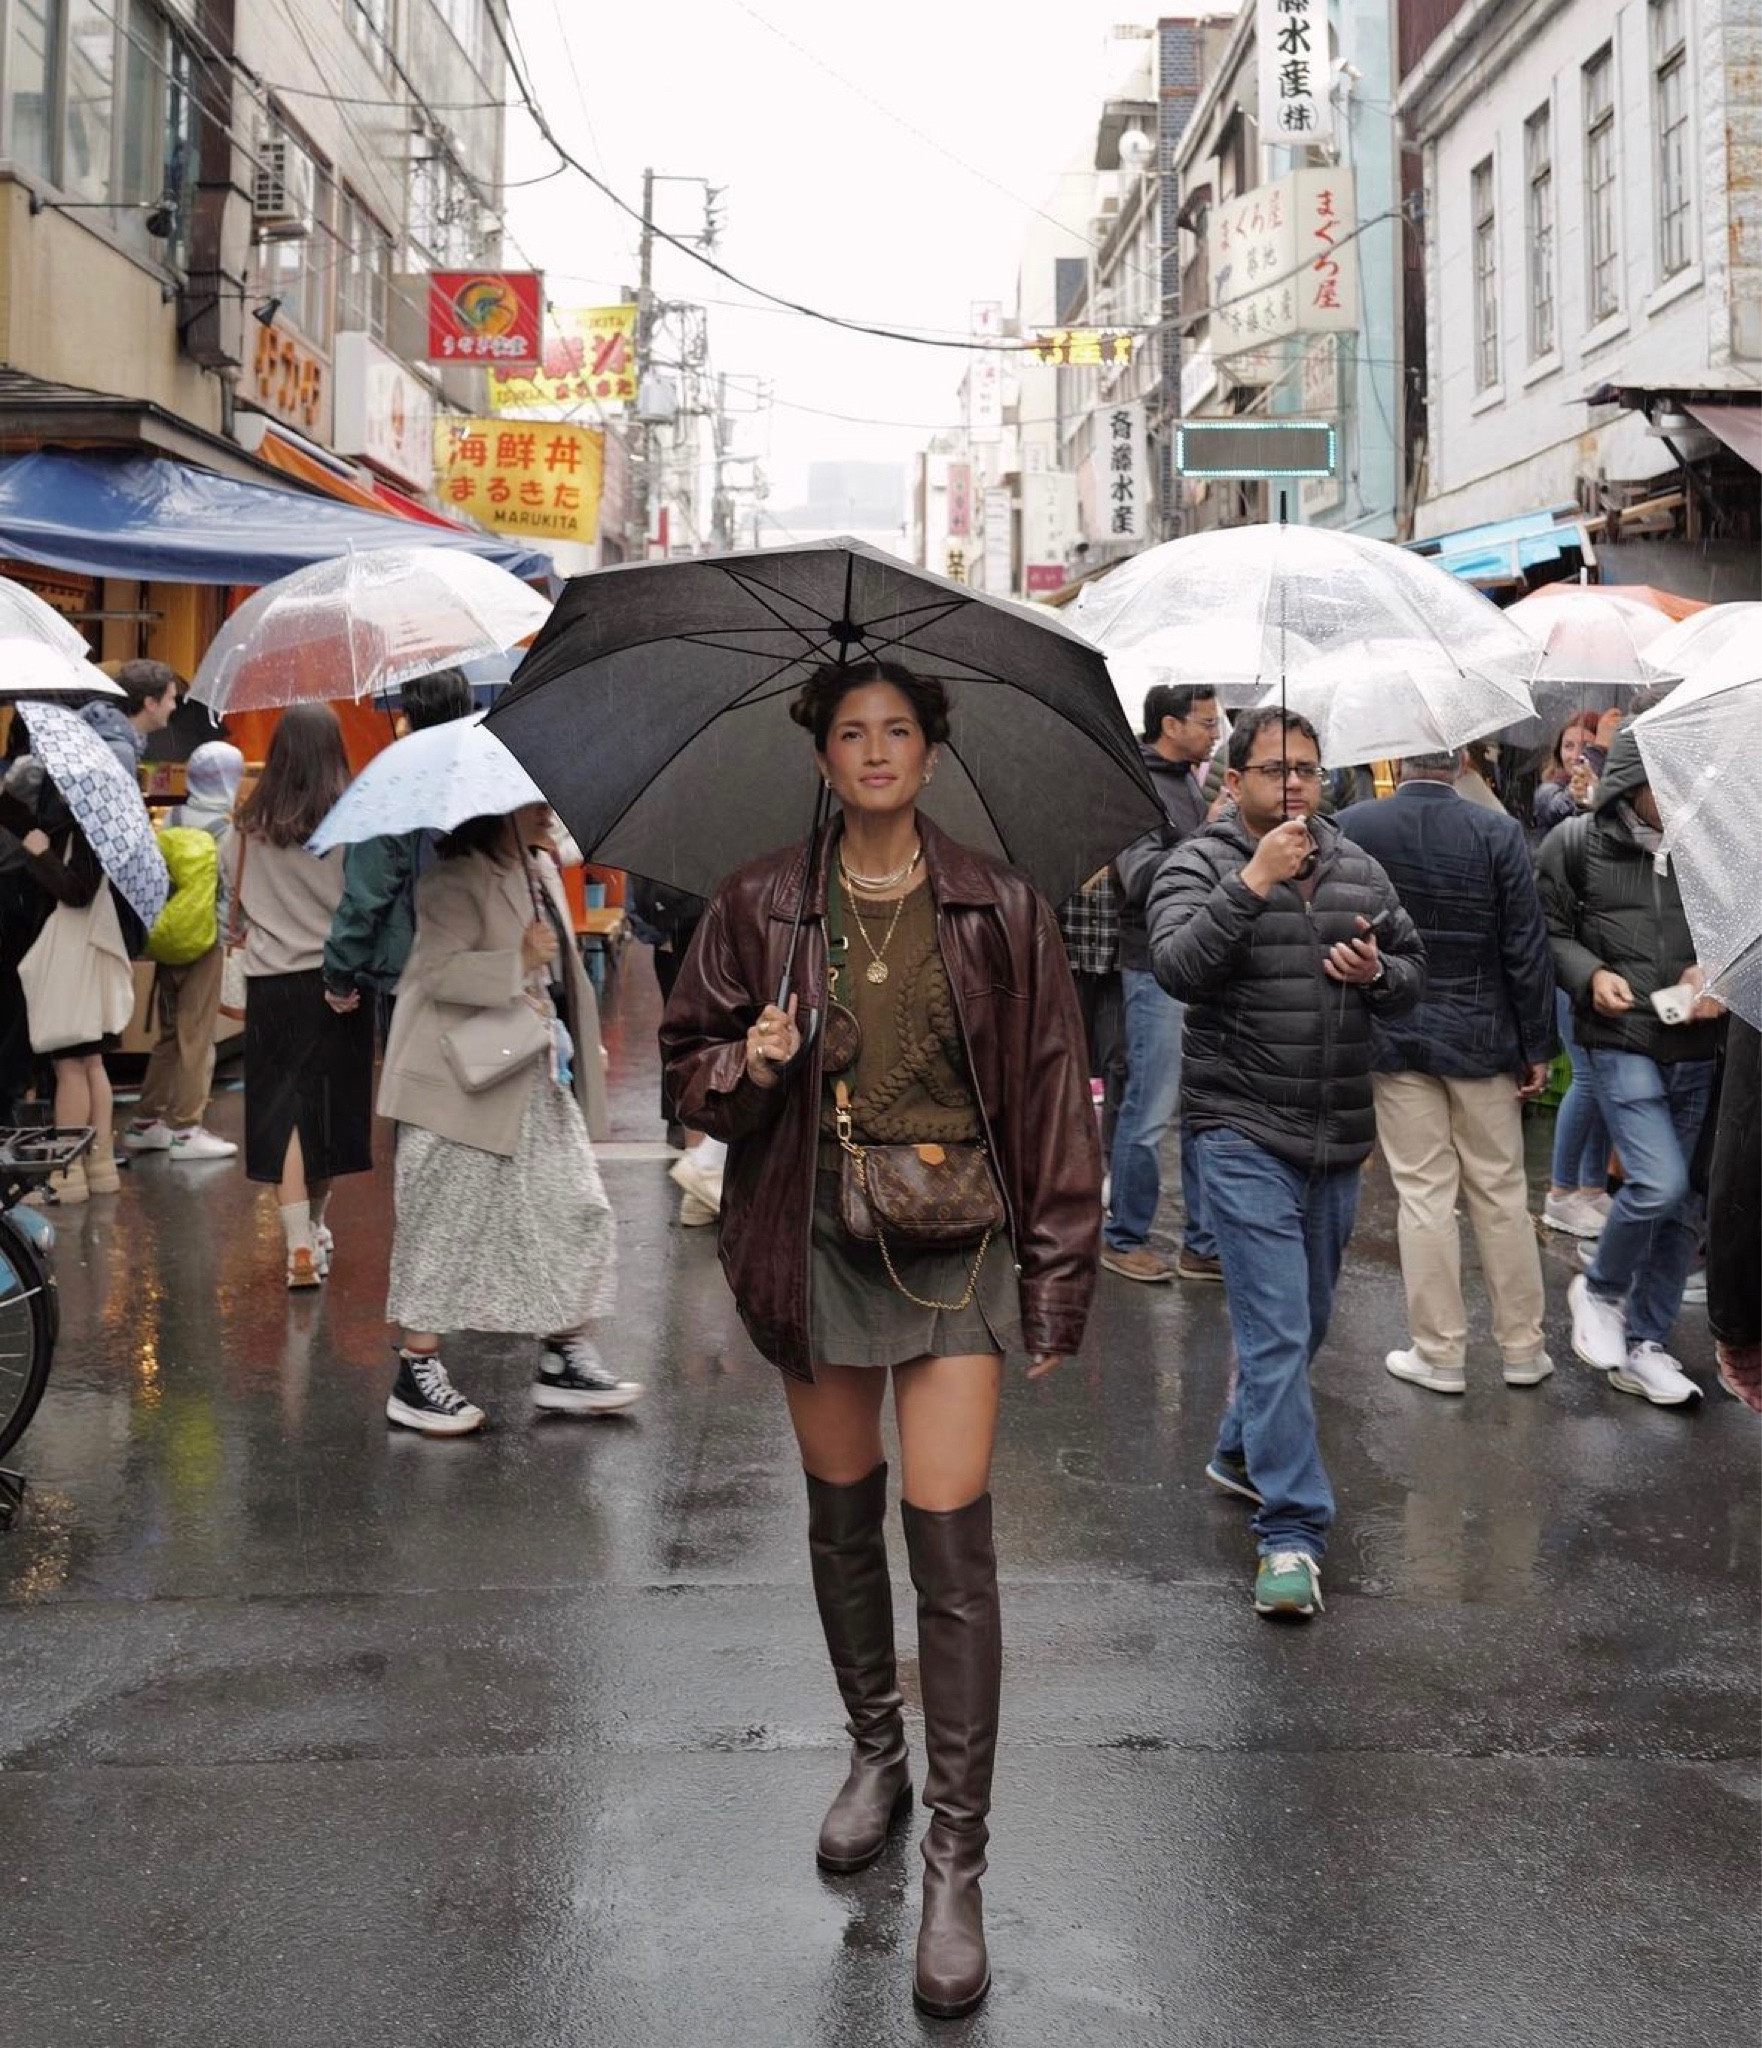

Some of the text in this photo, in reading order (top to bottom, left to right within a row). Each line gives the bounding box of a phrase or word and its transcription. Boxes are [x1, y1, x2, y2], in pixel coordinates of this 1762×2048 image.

[1313, 188, 1341, 309] まぐろ屋
[448, 425, 582, 474] 海鮮丼
[448, 476, 581, 510] まるきた
[494, 509, 579, 530] MARUKITA
